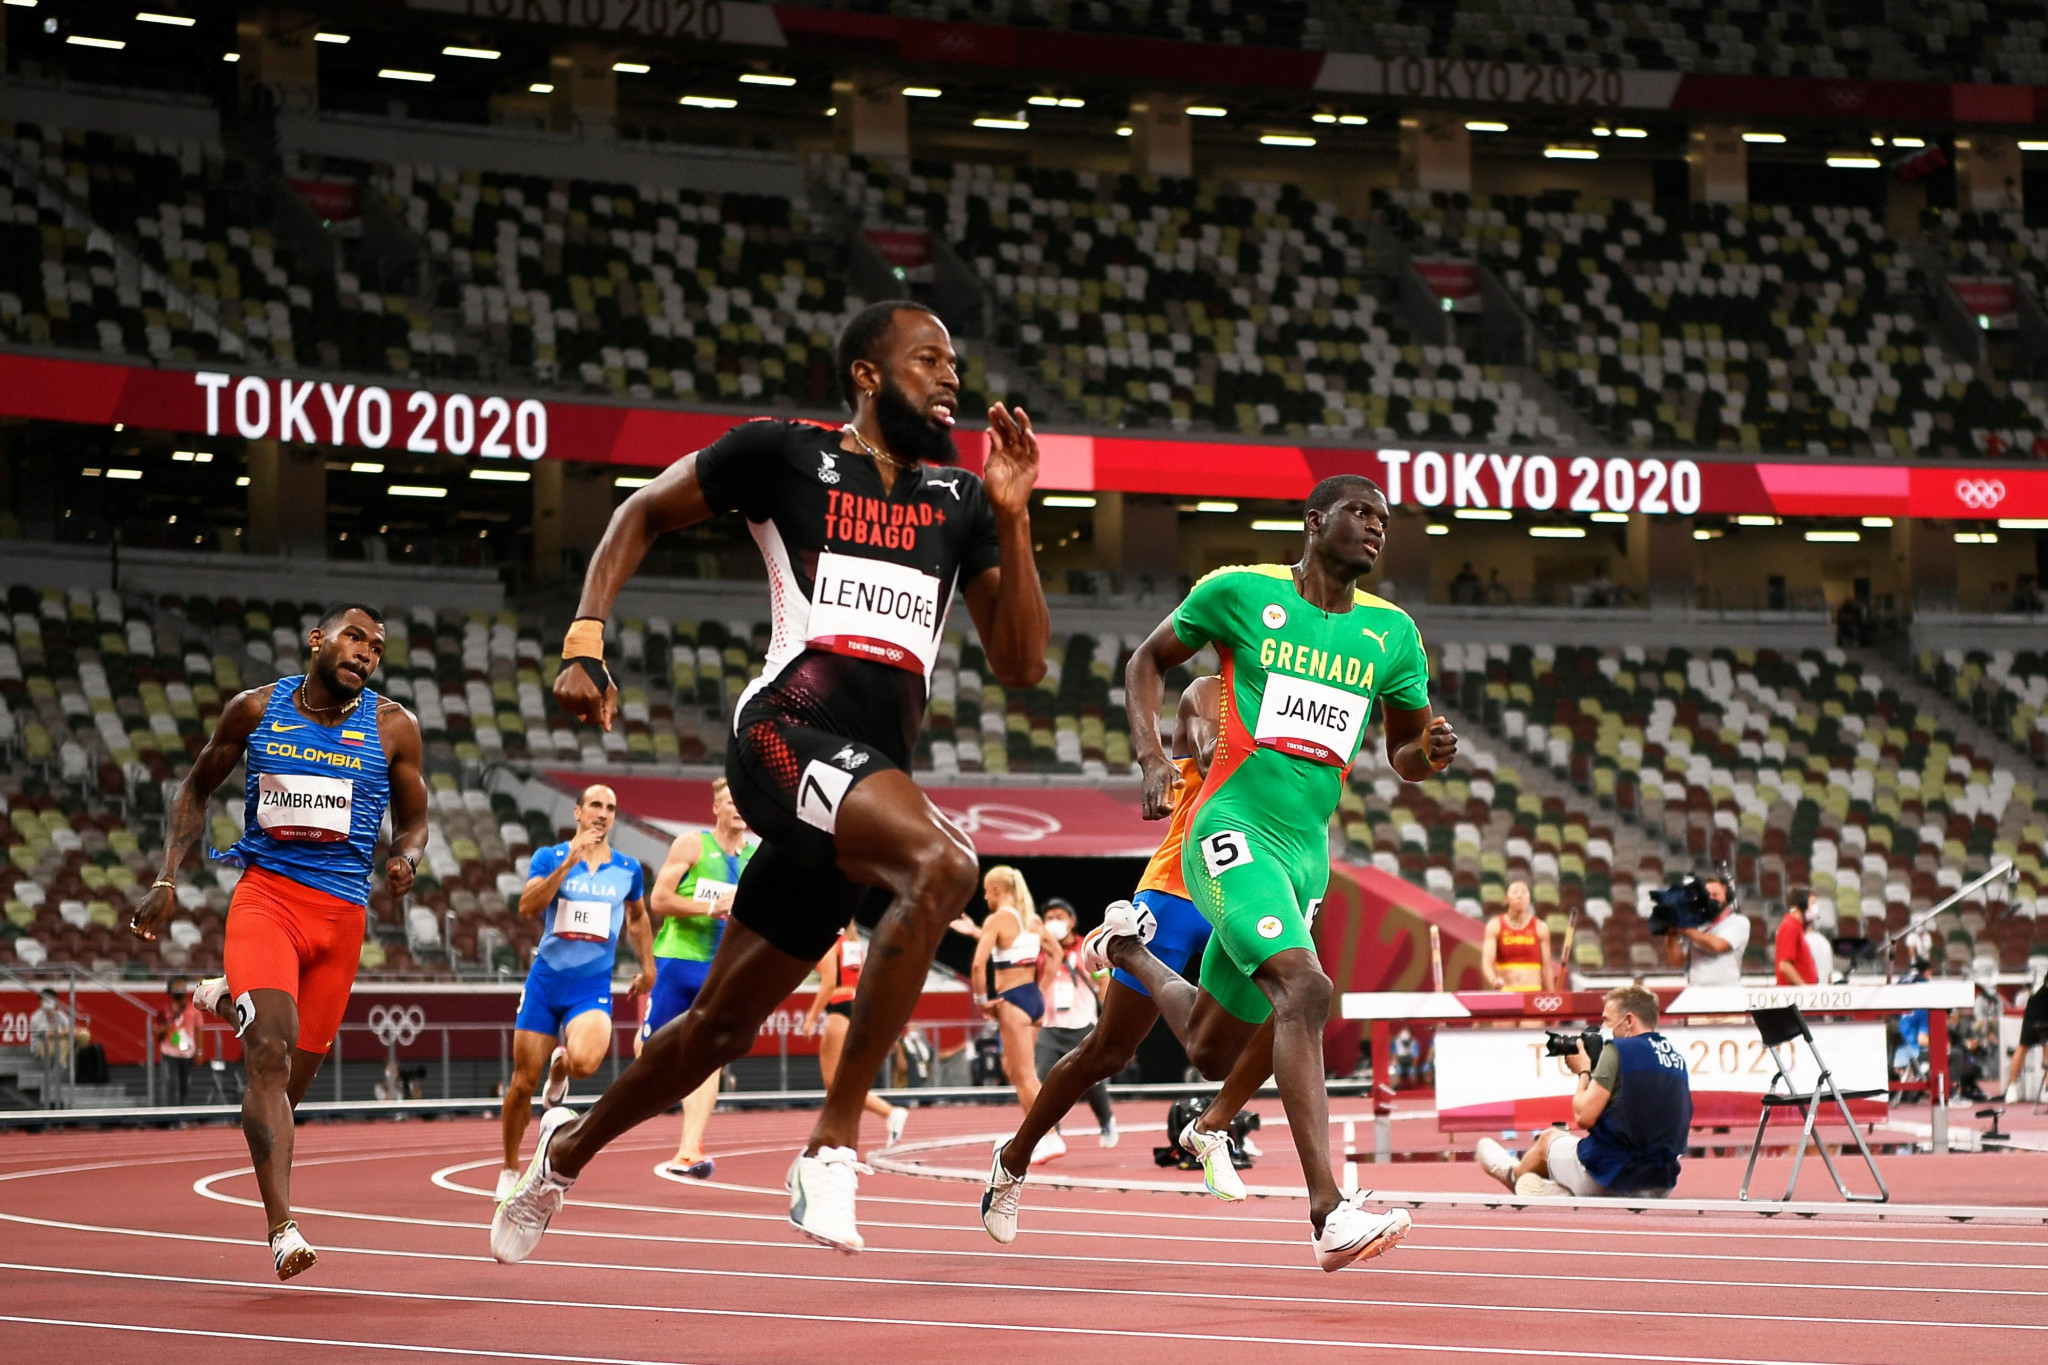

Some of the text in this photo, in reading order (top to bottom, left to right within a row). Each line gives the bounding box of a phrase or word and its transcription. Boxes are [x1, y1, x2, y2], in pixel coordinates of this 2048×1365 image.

[1376, 54, 1624, 107] TOKYO 2020
[195, 372, 547, 460] TOKYO 2020
[1376, 449, 1701, 515] TOKYO 2020
[825, 513, 916, 551] TOBAGO
[819, 576, 933, 628] LENDORE
[1259, 637, 1375, 690] GRENADA
[1276, 694, 1350, 732] JAMES
[266, 742, 362, 771] COLOMBIA
[263, 789, 347, 809] ZAMBRANO
[801, 774, 833, 814] 7
[1211, 833, 1239, 866] 5
[565, 879, 617, 897] ITALIA
[698, 888, 723, 900] JAN
[574, 910, 590, 924] RE
[1747, 992, 1852, 1009] TOKYO 2020
[1689, 1039, 1796, 1075] 2020
